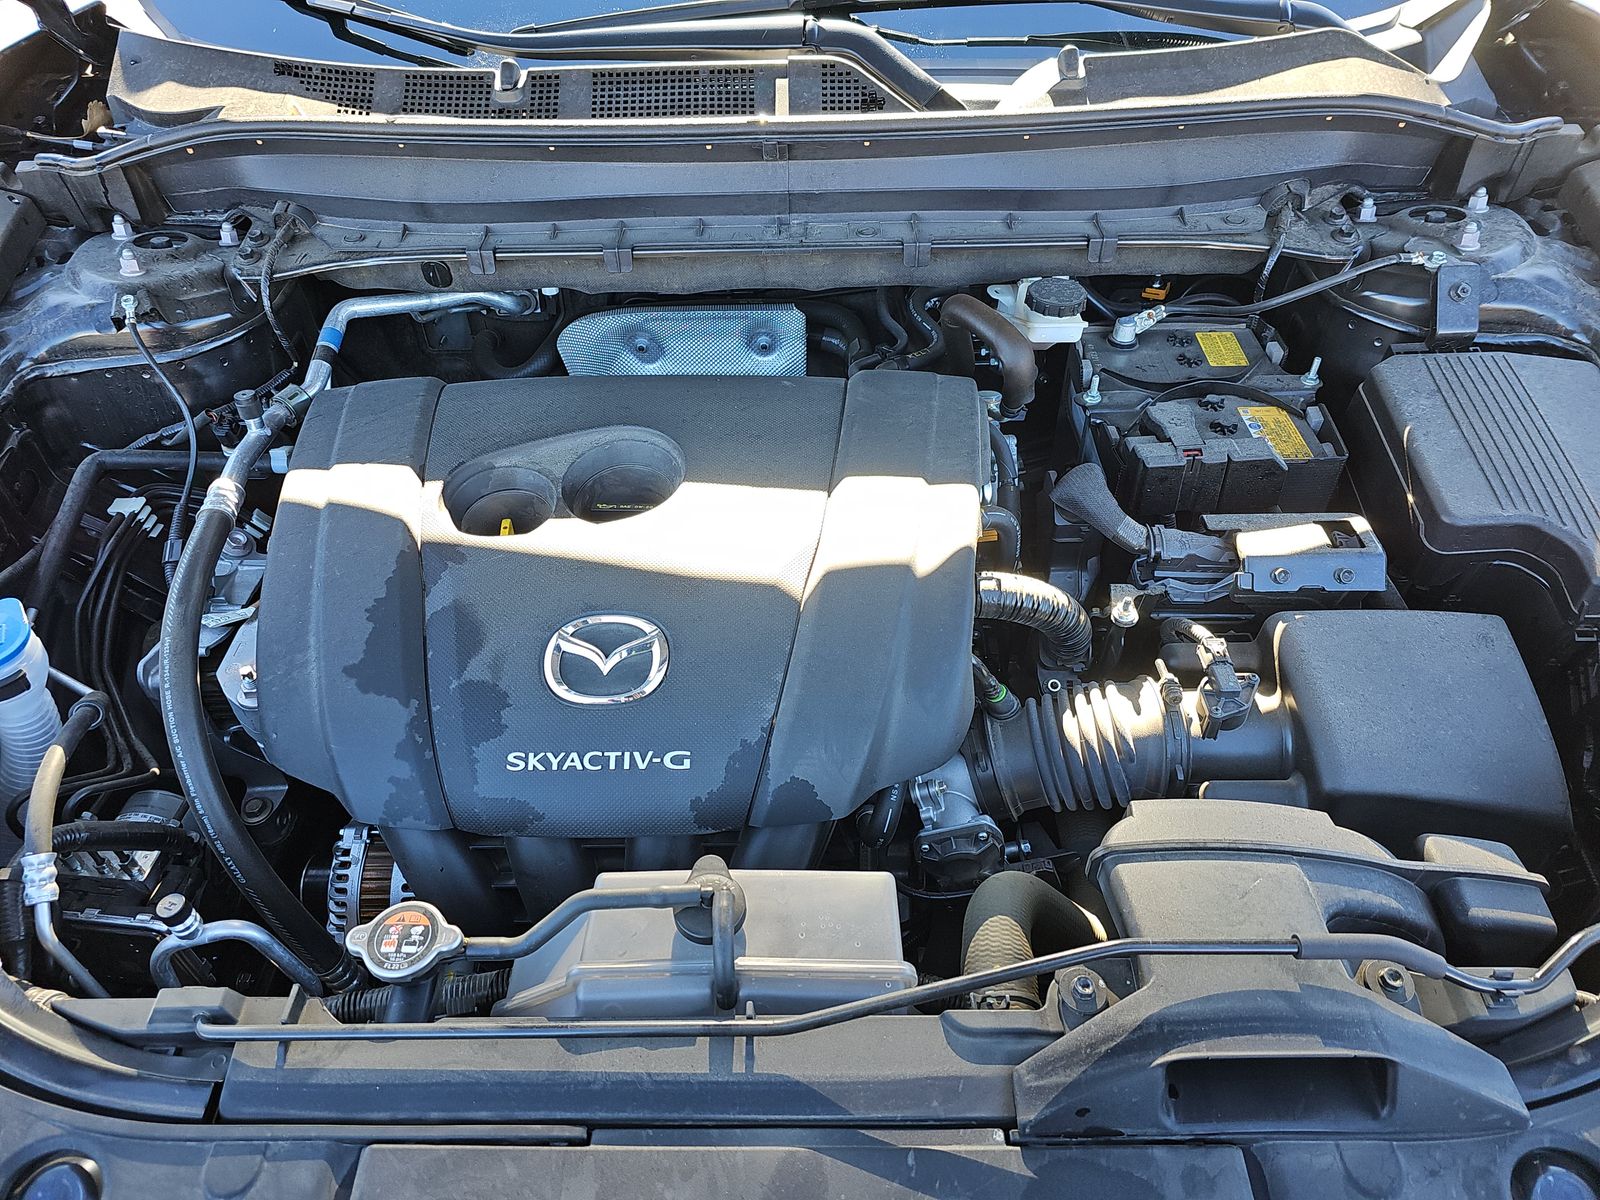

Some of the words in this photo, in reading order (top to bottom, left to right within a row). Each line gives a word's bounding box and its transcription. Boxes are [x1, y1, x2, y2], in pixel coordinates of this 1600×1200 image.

[168, 712, 179, 743] SUCTION
[175, 745, 184, 758] A/C
[506, 751, 691, 771] SKYACTIV-G
[180, 760, 197, 797] Flexbarrier
[223, 855, 246, 884] GALAXY
